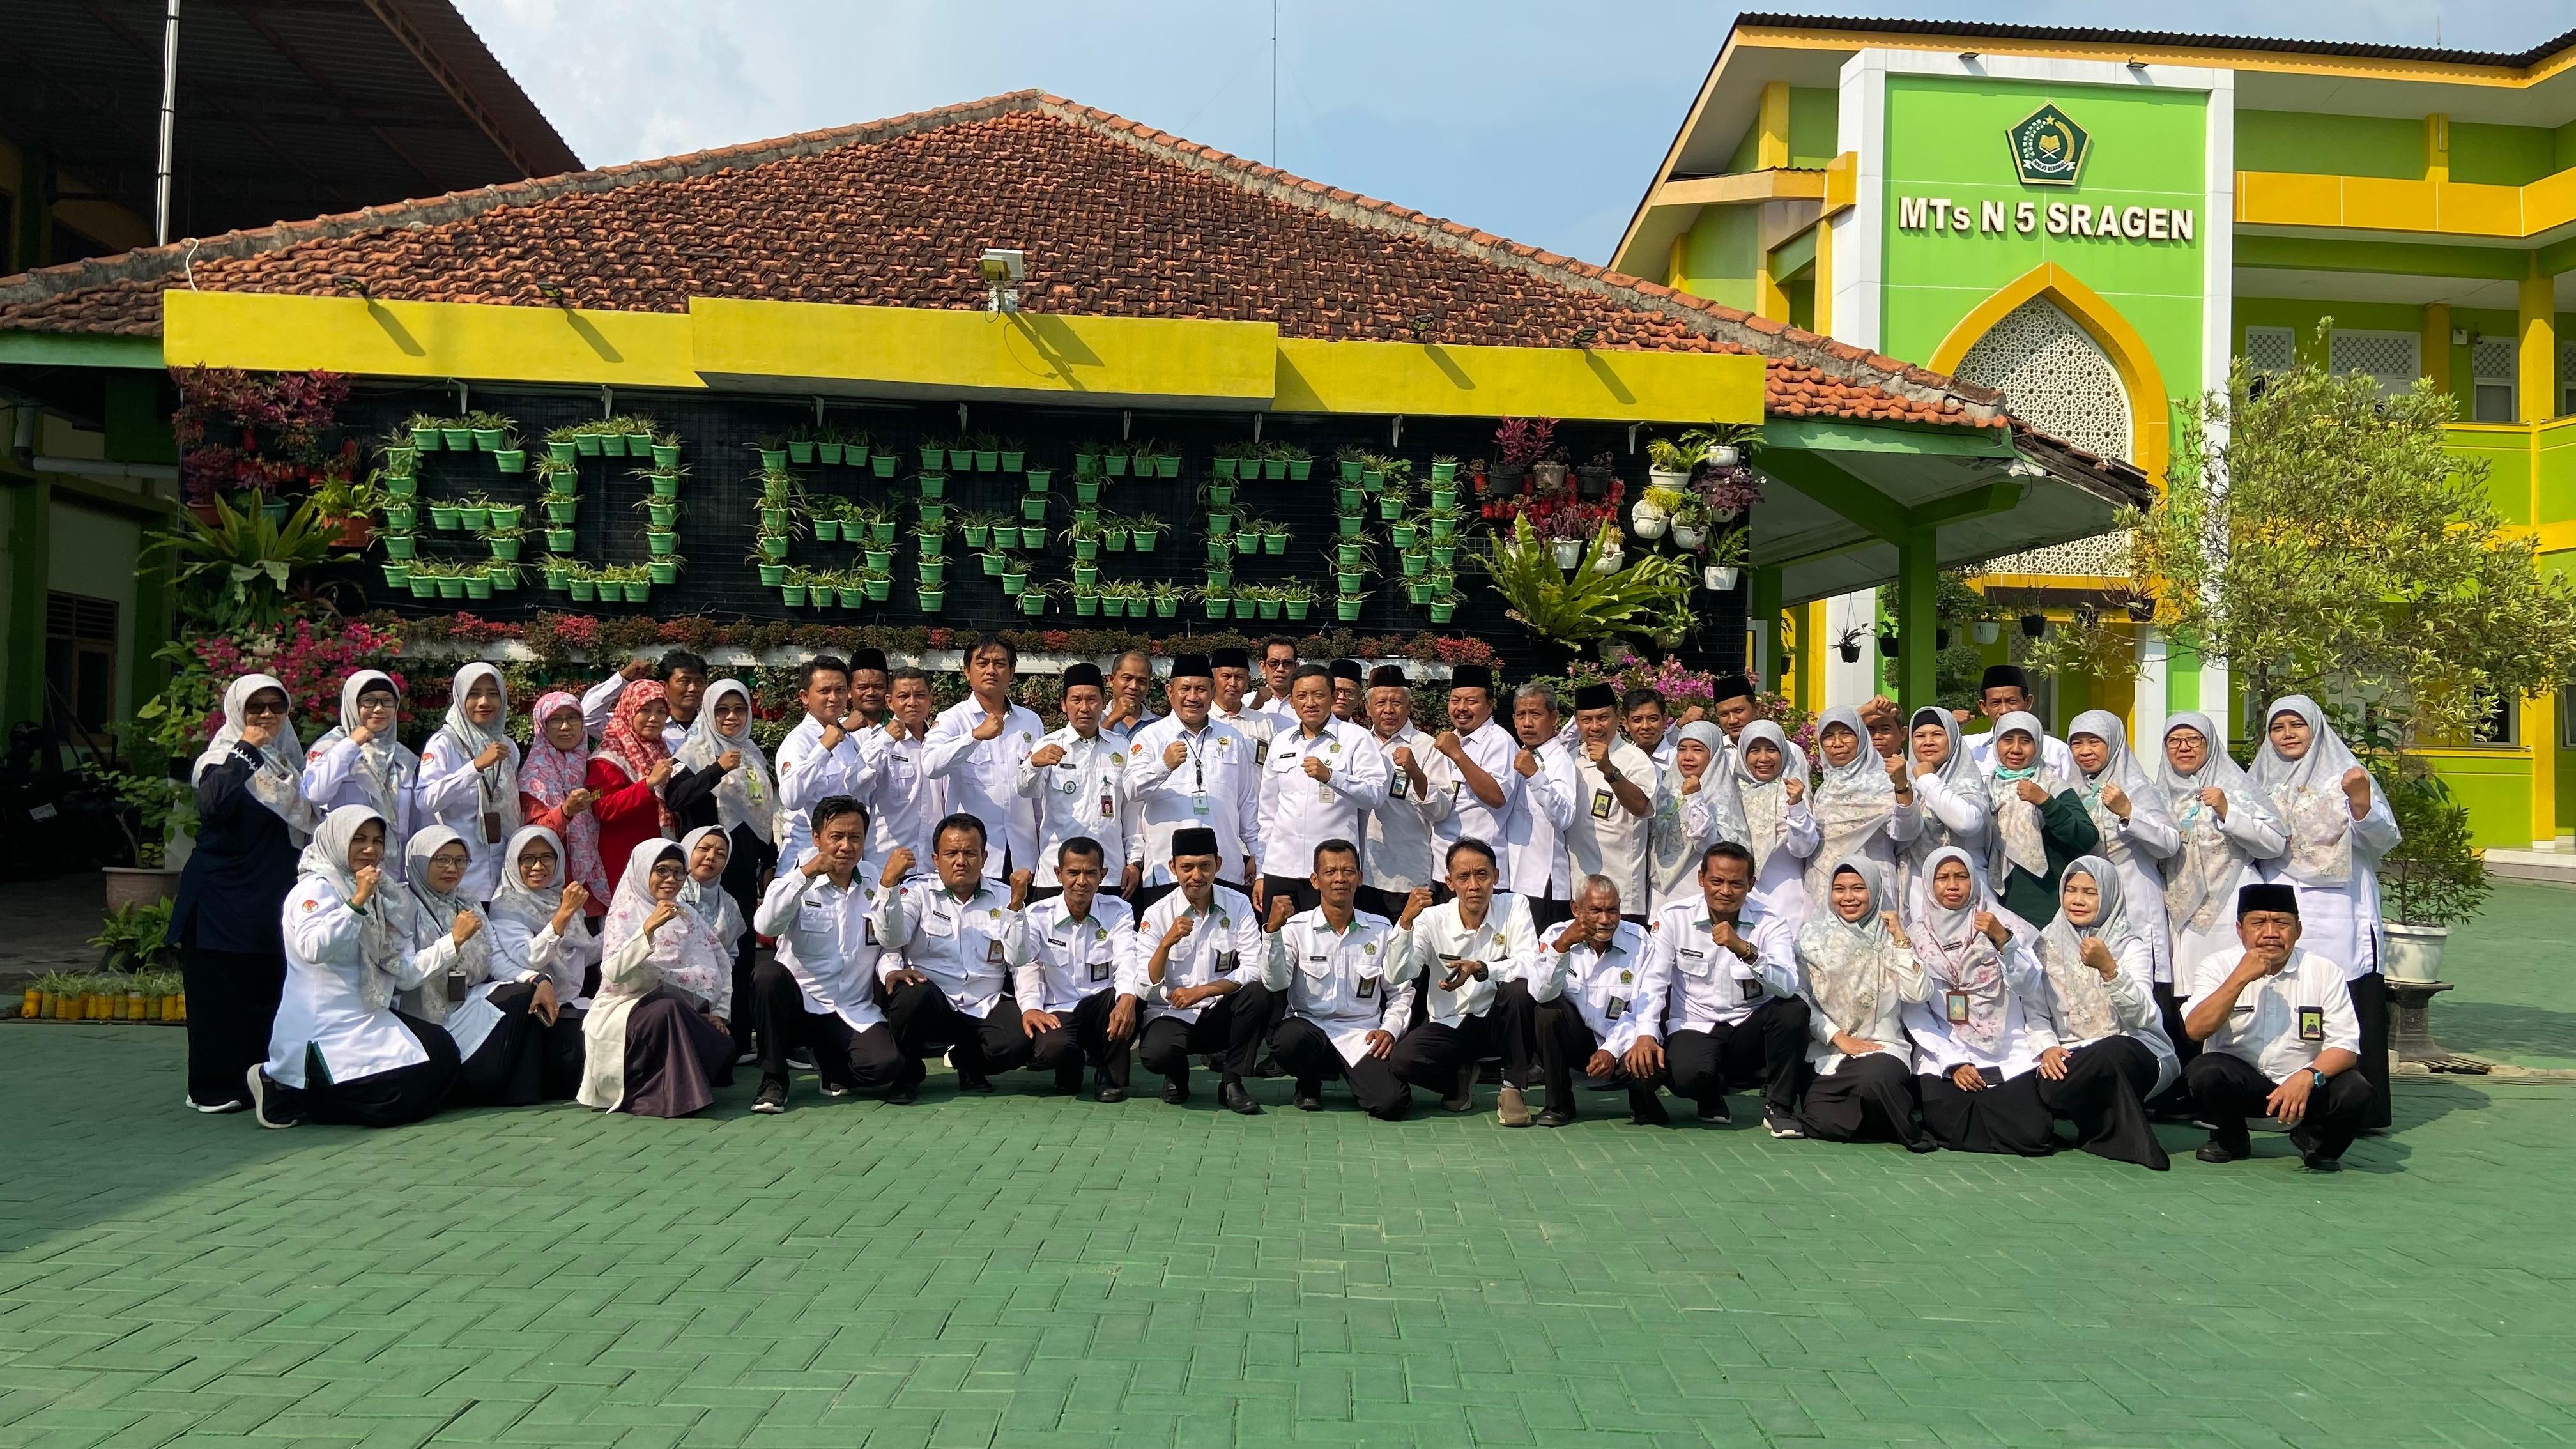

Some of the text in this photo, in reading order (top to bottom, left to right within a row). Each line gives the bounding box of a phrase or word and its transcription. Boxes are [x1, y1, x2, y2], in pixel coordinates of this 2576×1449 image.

[1899, 197, 2193, 240] MTs N 5 SRAGEN
[377, 415, 1463, 624] GO GREEN
